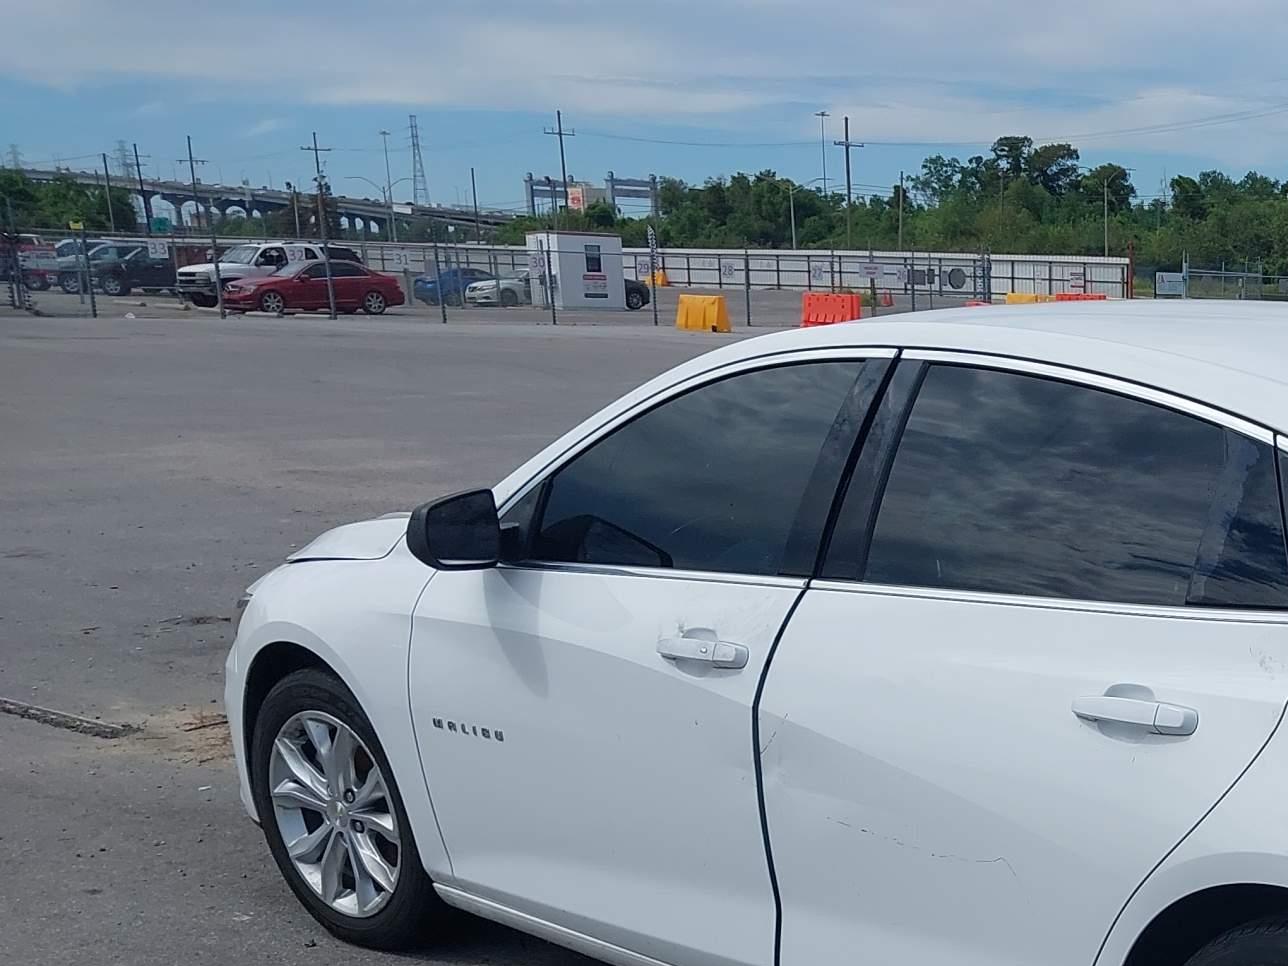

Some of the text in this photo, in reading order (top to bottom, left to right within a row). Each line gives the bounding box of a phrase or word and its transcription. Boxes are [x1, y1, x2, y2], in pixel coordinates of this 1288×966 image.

[150, 242, 168, 254] 33
[289, 249, 304, 261] 32
[393, 253, 408, 265] 31
[533, 257, 545, 268] 30
[639, 263, 650, 273] 29
[722, 265, 734, 276] 28
[432, 717, 504, 742] MALIBU
